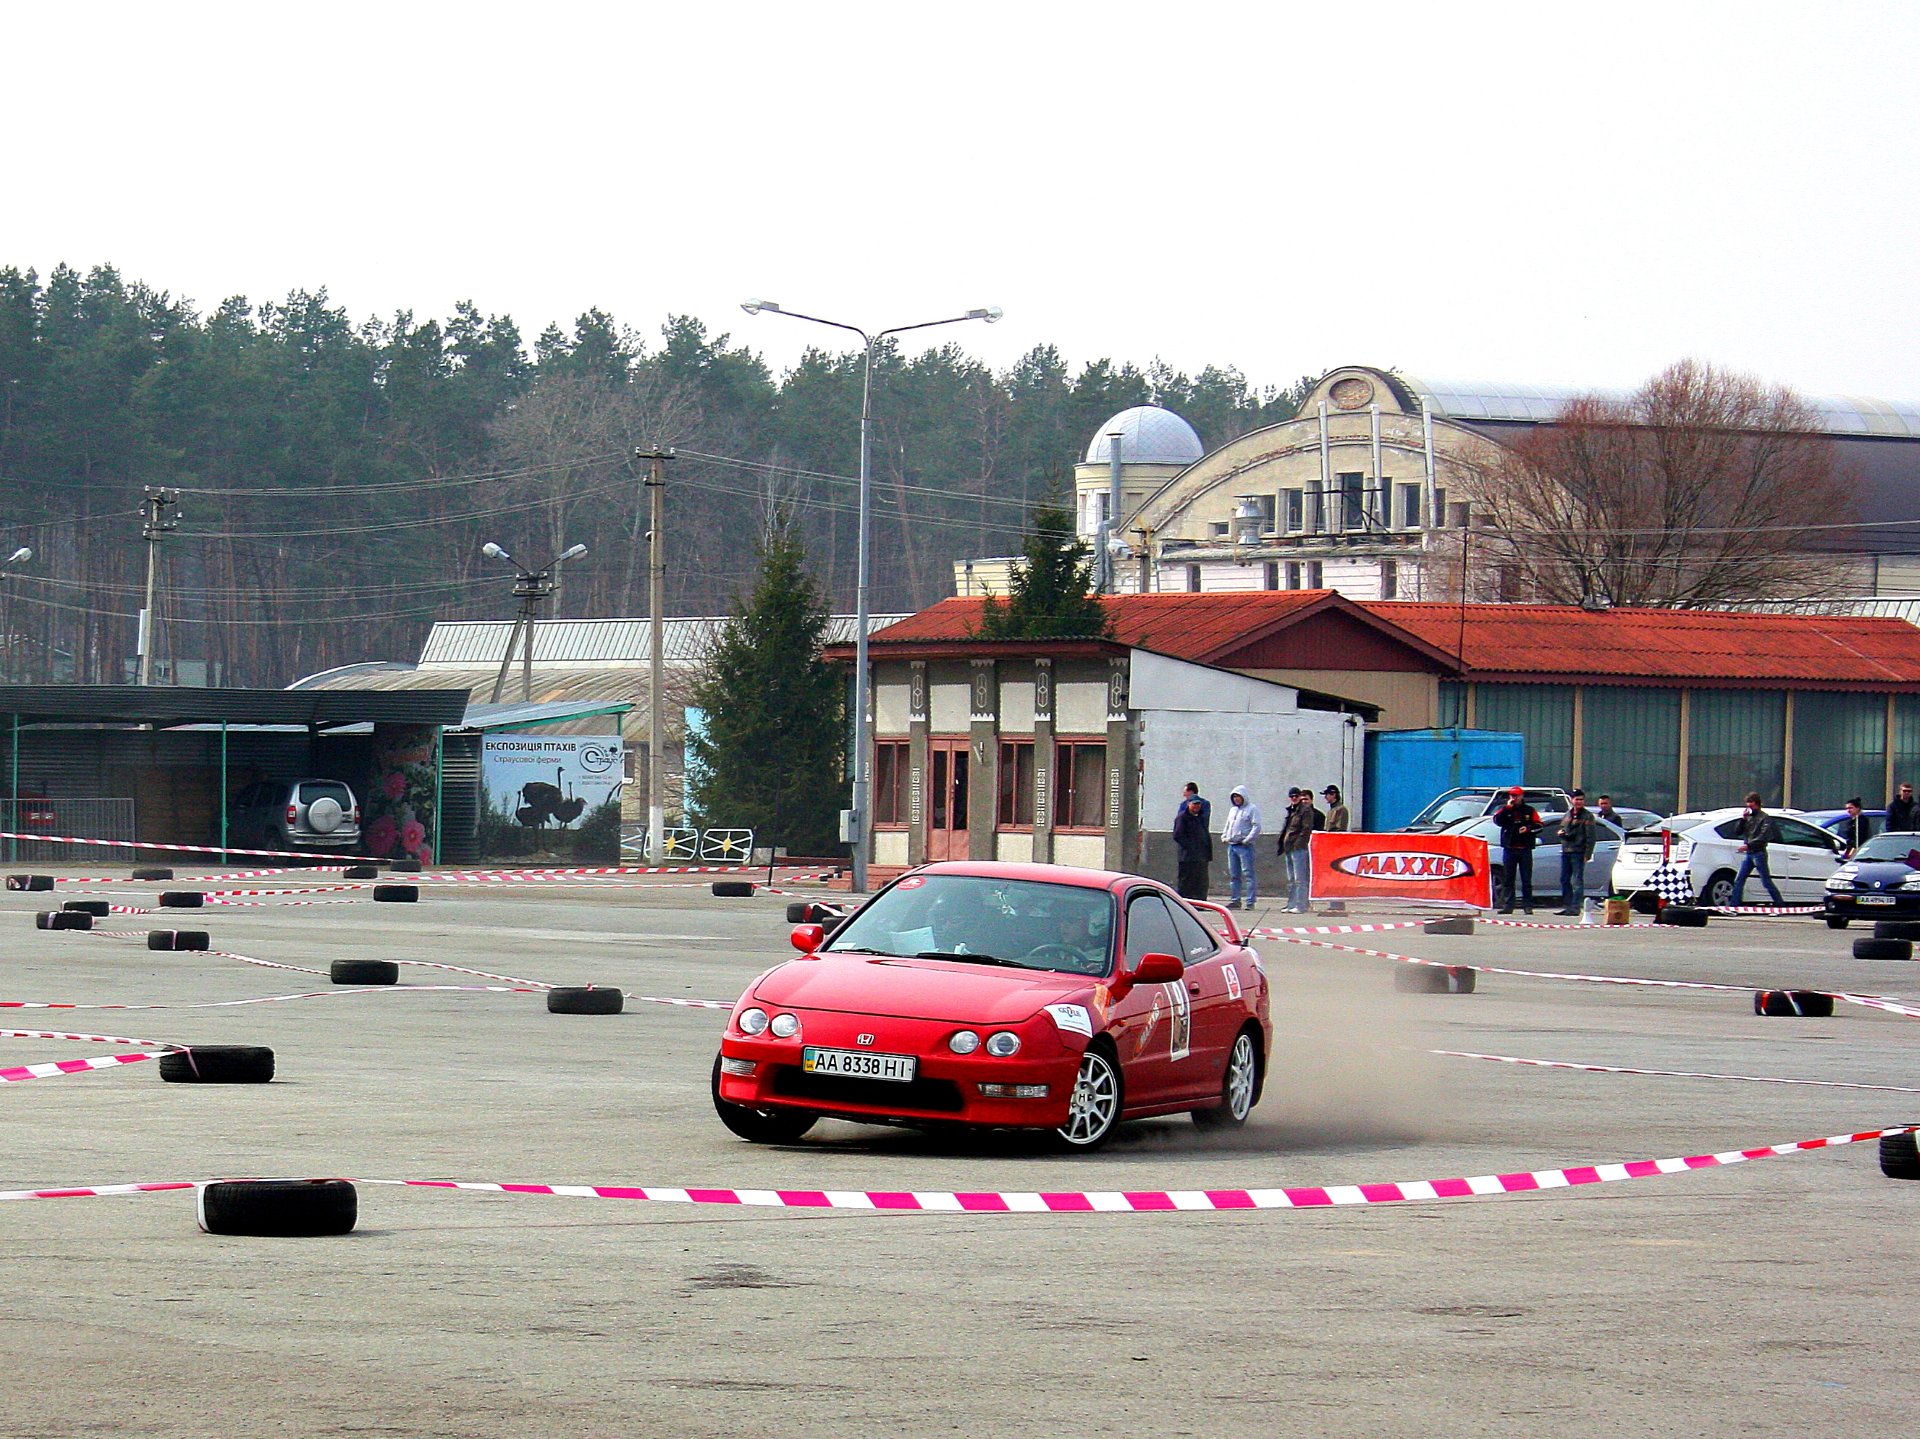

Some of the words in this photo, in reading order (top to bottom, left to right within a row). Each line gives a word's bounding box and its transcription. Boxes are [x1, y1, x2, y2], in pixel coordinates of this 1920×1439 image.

[485, 742, 542, 752] ЕКСПОЗИЦІЯ
[544, 742, 577, 752] ПТАХІВ
[1355, 855, 1456, 877] MAXXIS
[815, 1053, 838, 1071] AA
[843, 1055, 880, 1075] 8338
[885, 1059, 905, 1078] HI
